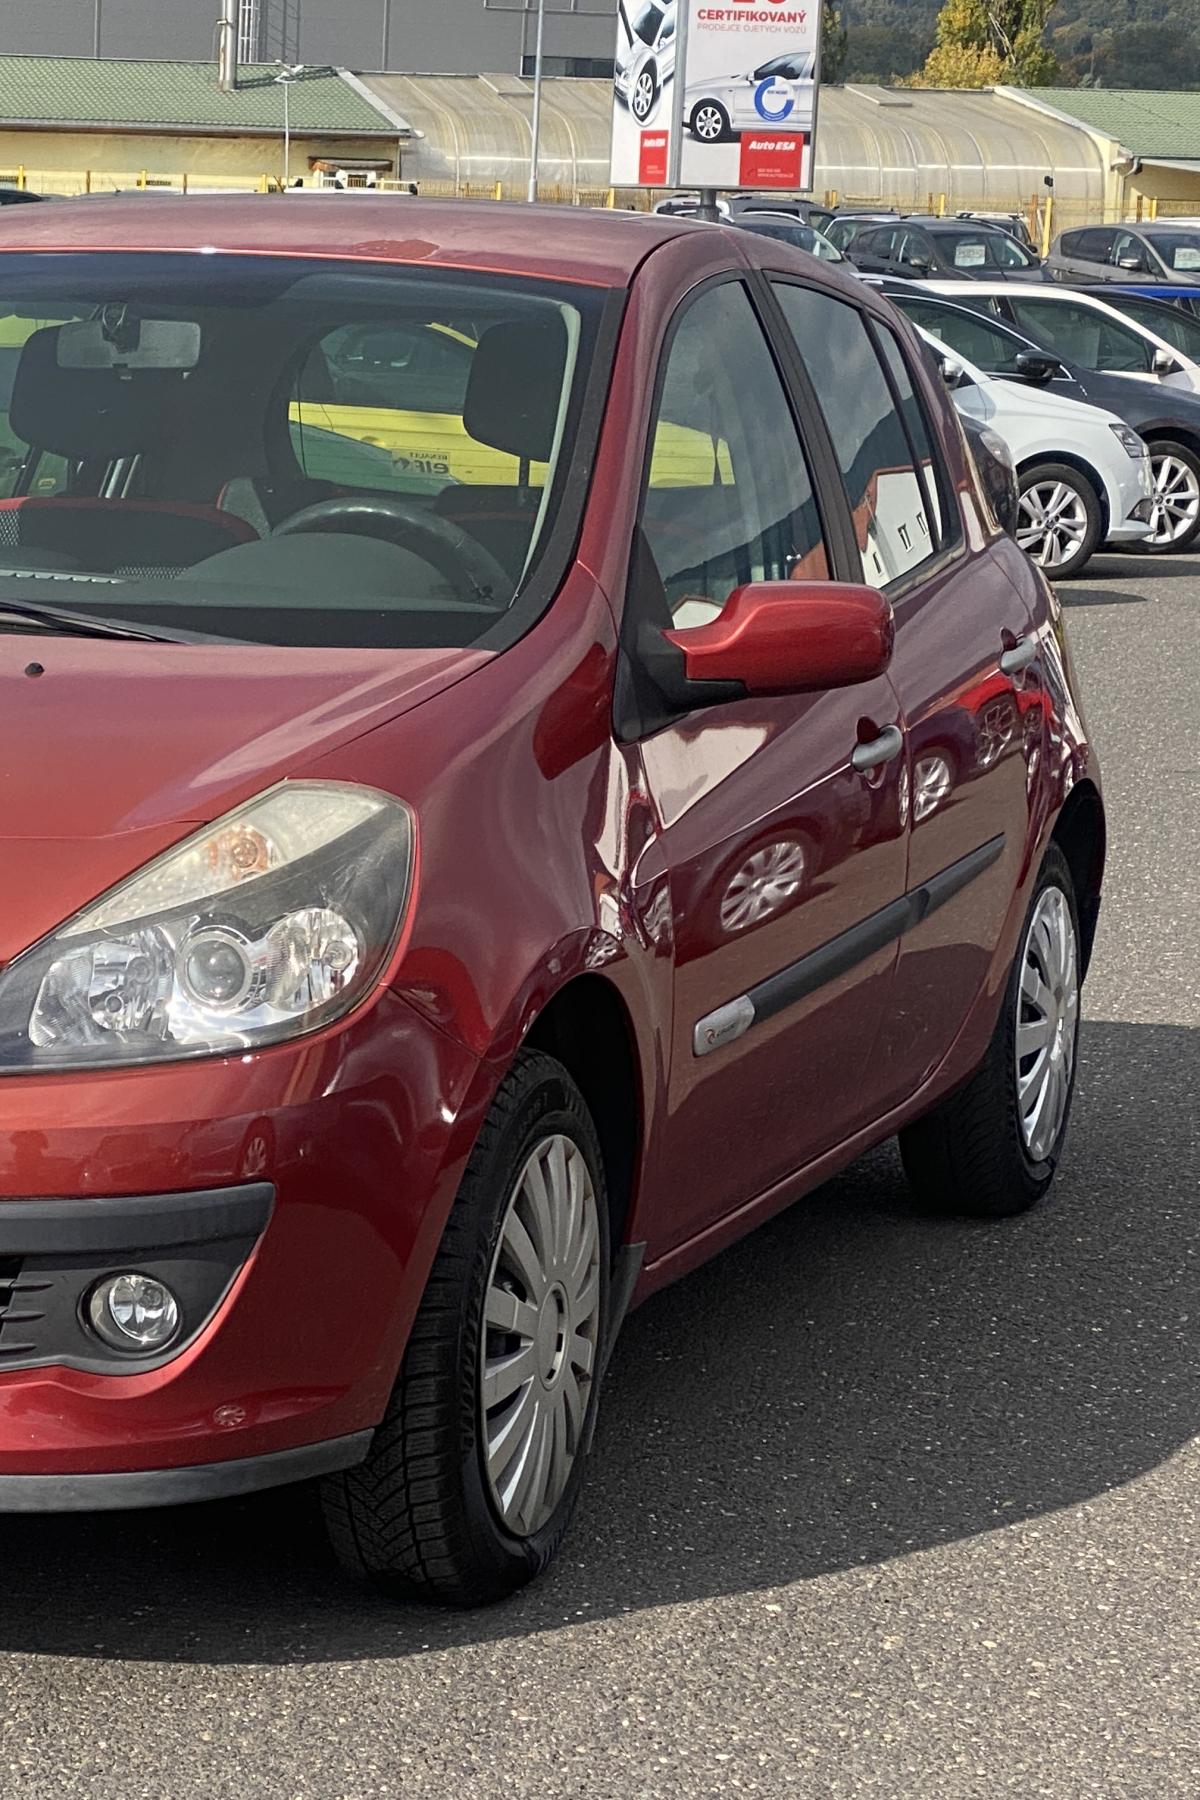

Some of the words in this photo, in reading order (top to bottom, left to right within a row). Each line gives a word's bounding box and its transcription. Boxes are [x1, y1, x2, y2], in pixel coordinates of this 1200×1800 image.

[697, 9, 807, 23] CERTIFIKOVANÝ
[748, 141, 775, 150] Auto
[775, 142, 796, 151] ESA
